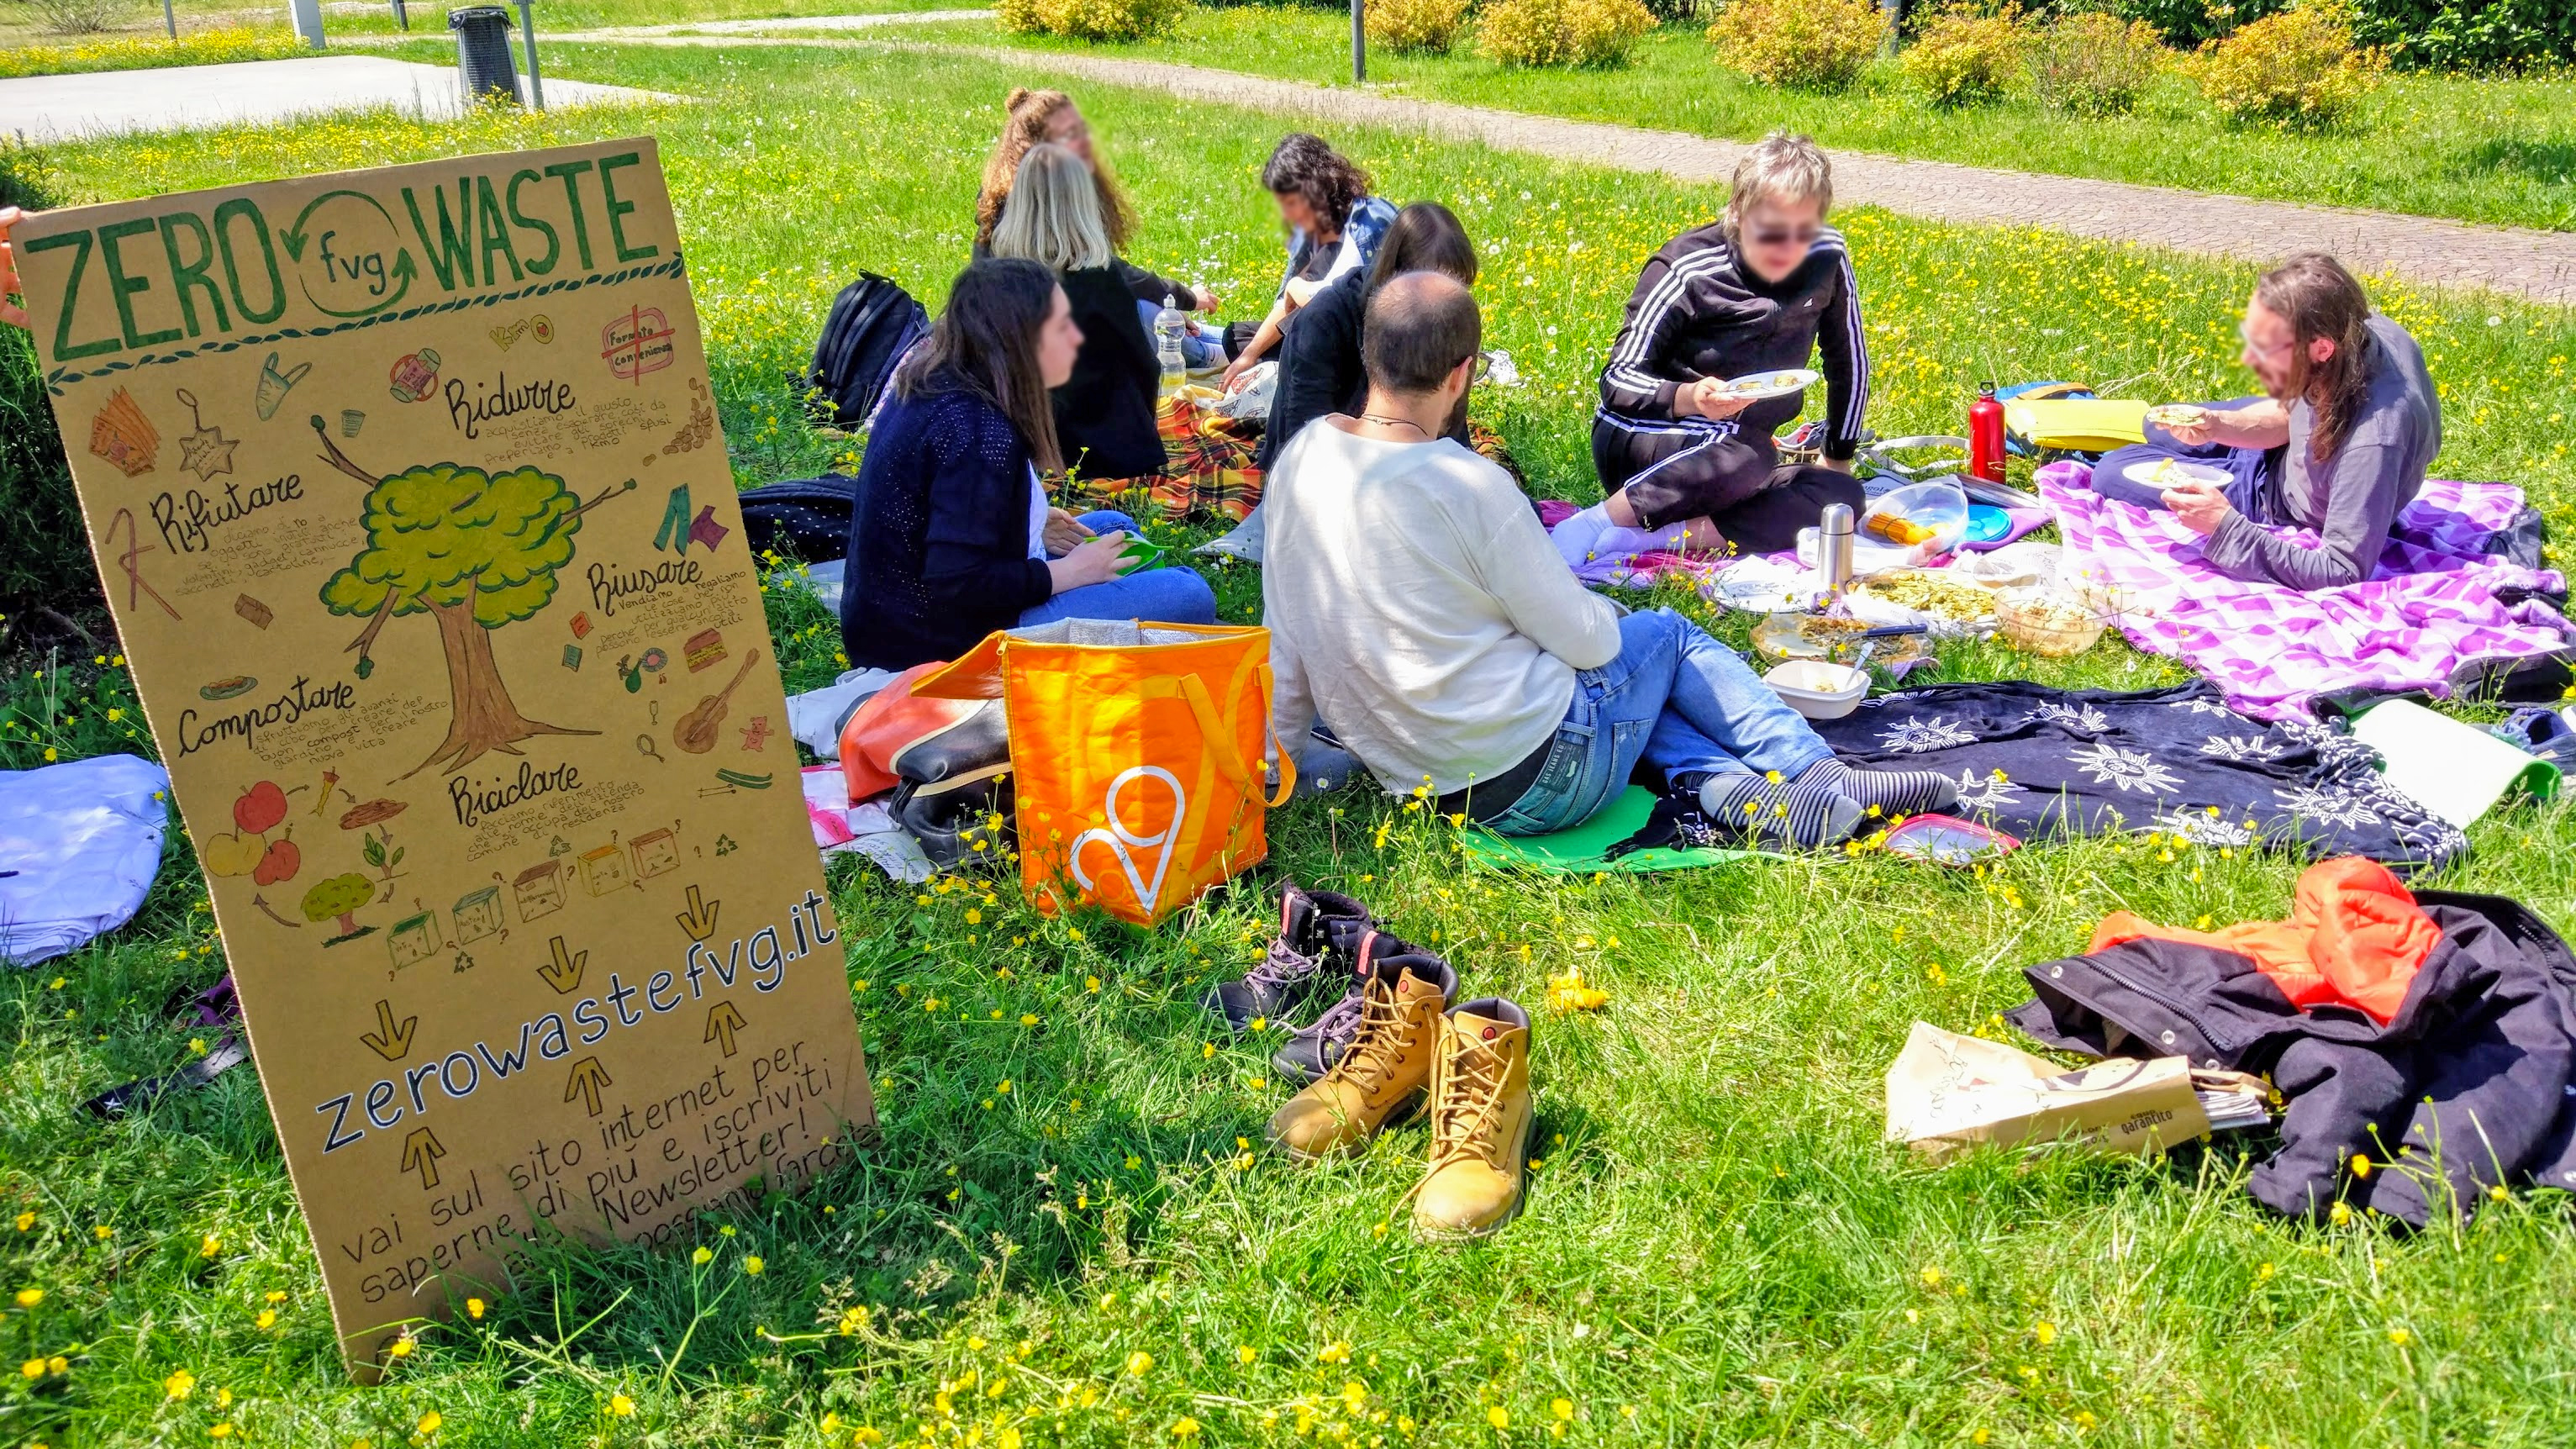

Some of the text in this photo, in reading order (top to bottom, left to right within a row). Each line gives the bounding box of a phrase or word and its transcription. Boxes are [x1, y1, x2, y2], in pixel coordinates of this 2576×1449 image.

[24, 152, 660, 362] ZERO fvg WASTE
[445, 371, 576, 440] Ridurre
[484, 413, 564, 439] acquistiamo
[575, 405, 586, 418] il
[511, 427, 546, 440] senza
[650, 399, 666, 411] da
[514, 432, 562, 449] evitare
[572, 429, 590, 441] gli
[582, 427, 627, 450] prodotti
[149, 474, 303, 555] Rifiutare
[210, 538, 263, 561] oggetti
[322, 517, 357, 531] anche
[224, 524, 270, 544] diciamo
[293, 517, 307, 527] no
[243, 549, 272, 560] sono
[587, 560, 703, 617] Riusare
[619, 590, 672, 609] Vendiamo
[695, 571, 746, 593] regaliamo
[631, 602, 702, 624] utilizziamo
[645, 582, 738, 612] le cose che non
[596, 611, 744, 659] possono essere ancora utili
[644, 620, 659, 636] per
[178, 675, 357, 758] Compostare
[253, 743, 266, 756] di
[279, 733, 306, 748] cibo
[319, 723, 338, 737] per
[351, 707, 395, 724] creare
[255, 693, 399, 745] sfruttiamo gli avanzi
[259, 700, 449, 762] buon compost per il nostro
[273, 744, 331, 770] giardino
[375, 718, 418, 735] creare
[309, 735, 385, 766] nuova vita
[448, 761, 582, 827] Riciclare
[1542, 772, 1552, 784] GAS
[1549, 755, 1561, 772] JEANS
[468, 788, 645, 853] che si occupa del nostro
[475, 830, 499, 843] alle
[508, 812, 547, 830] norme
[480, 780, 614, 832] facciamo riferimento
[466, 804, 626, 862] comune di residenza
[314, 888, 838, 1155] zerowastefvg.it
[341, 1041, 805, 1265] vai sul sito internet per
[599, 1107, 809, 1230] Newsletter!
[361, 1215, 514, 1304] saperne
[538, 1178, 568, 1220] di
[662, 1139, 685, 1163] e
[702, 1056, 834, 1146] iscriviti
